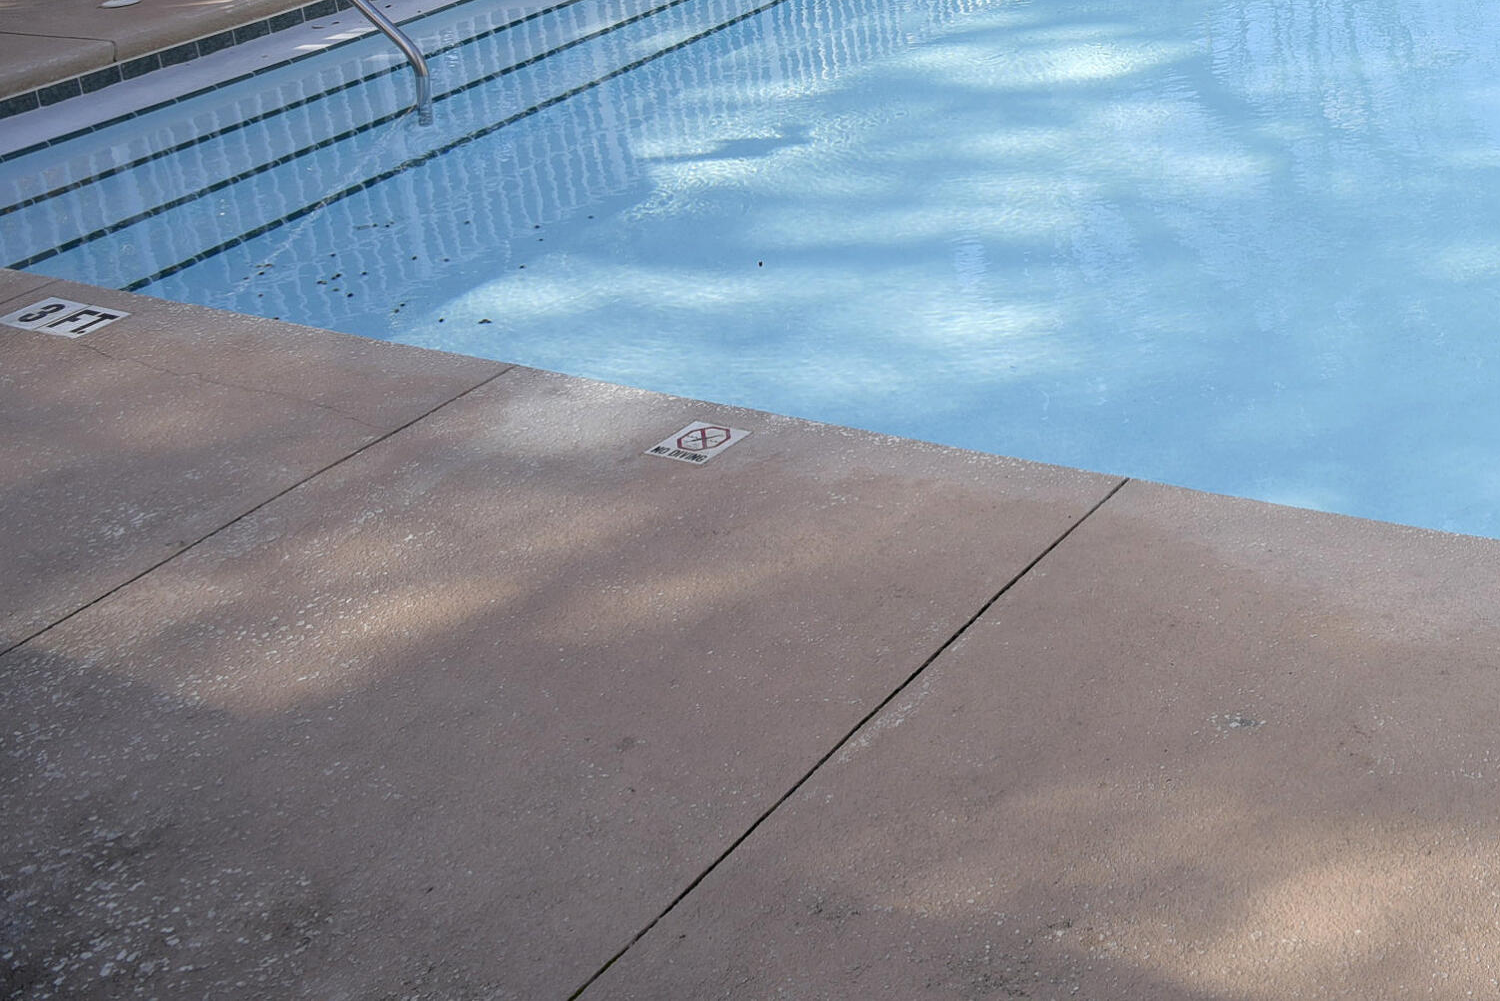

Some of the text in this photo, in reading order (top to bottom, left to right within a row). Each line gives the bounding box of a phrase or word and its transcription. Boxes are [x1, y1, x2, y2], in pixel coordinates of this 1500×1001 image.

[17, 303, 66, 323] 3
[650, 445, 708, 462] NO DIVING
